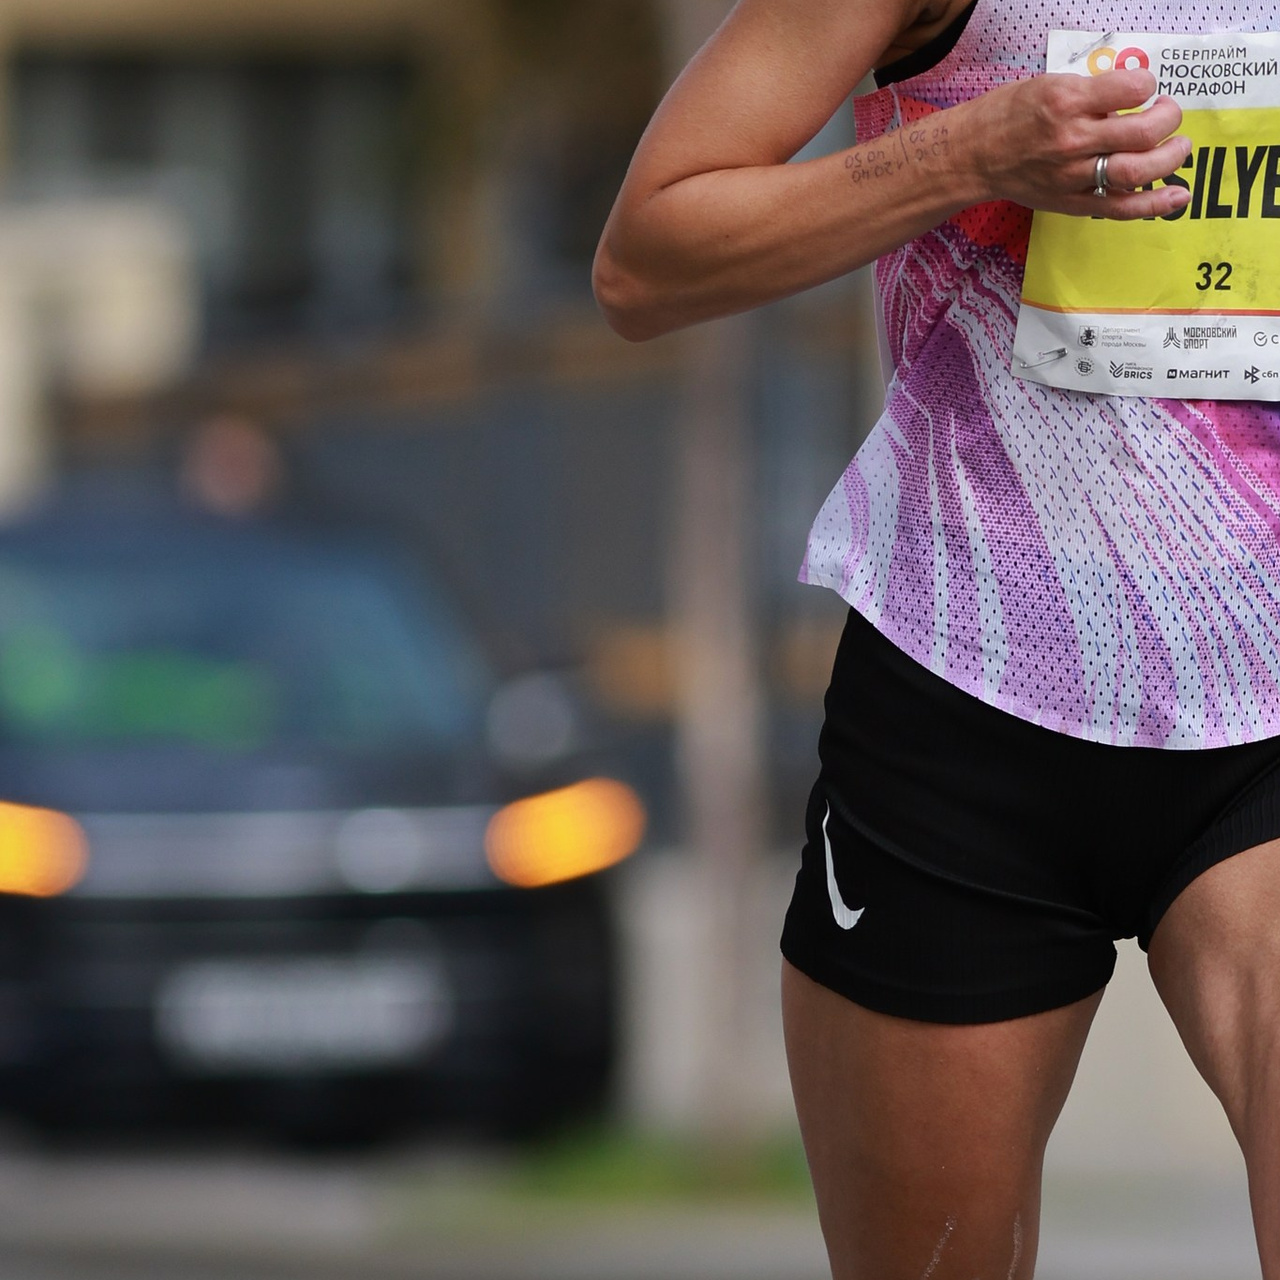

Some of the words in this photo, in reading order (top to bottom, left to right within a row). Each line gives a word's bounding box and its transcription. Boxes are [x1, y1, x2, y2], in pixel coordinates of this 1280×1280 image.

[1161, 46, 1247, 61] СБЕРПРАЙМ
[1159, 59, 1278, 78] МОСКОВСКИЙ
[1158, 80, 1246, 96] МАРАФОН
[1195, 261, 1233, 291] 32
[1183, 325, 1238, 339] МОСКОВСКИЙ
[1184, 338, 1209, 350] СПОРТ
[1123, 371, 1153, 379] BRICS
[1180, 369, 1230, 379] магнит
[1261, 370, 1279, 378] сбп
